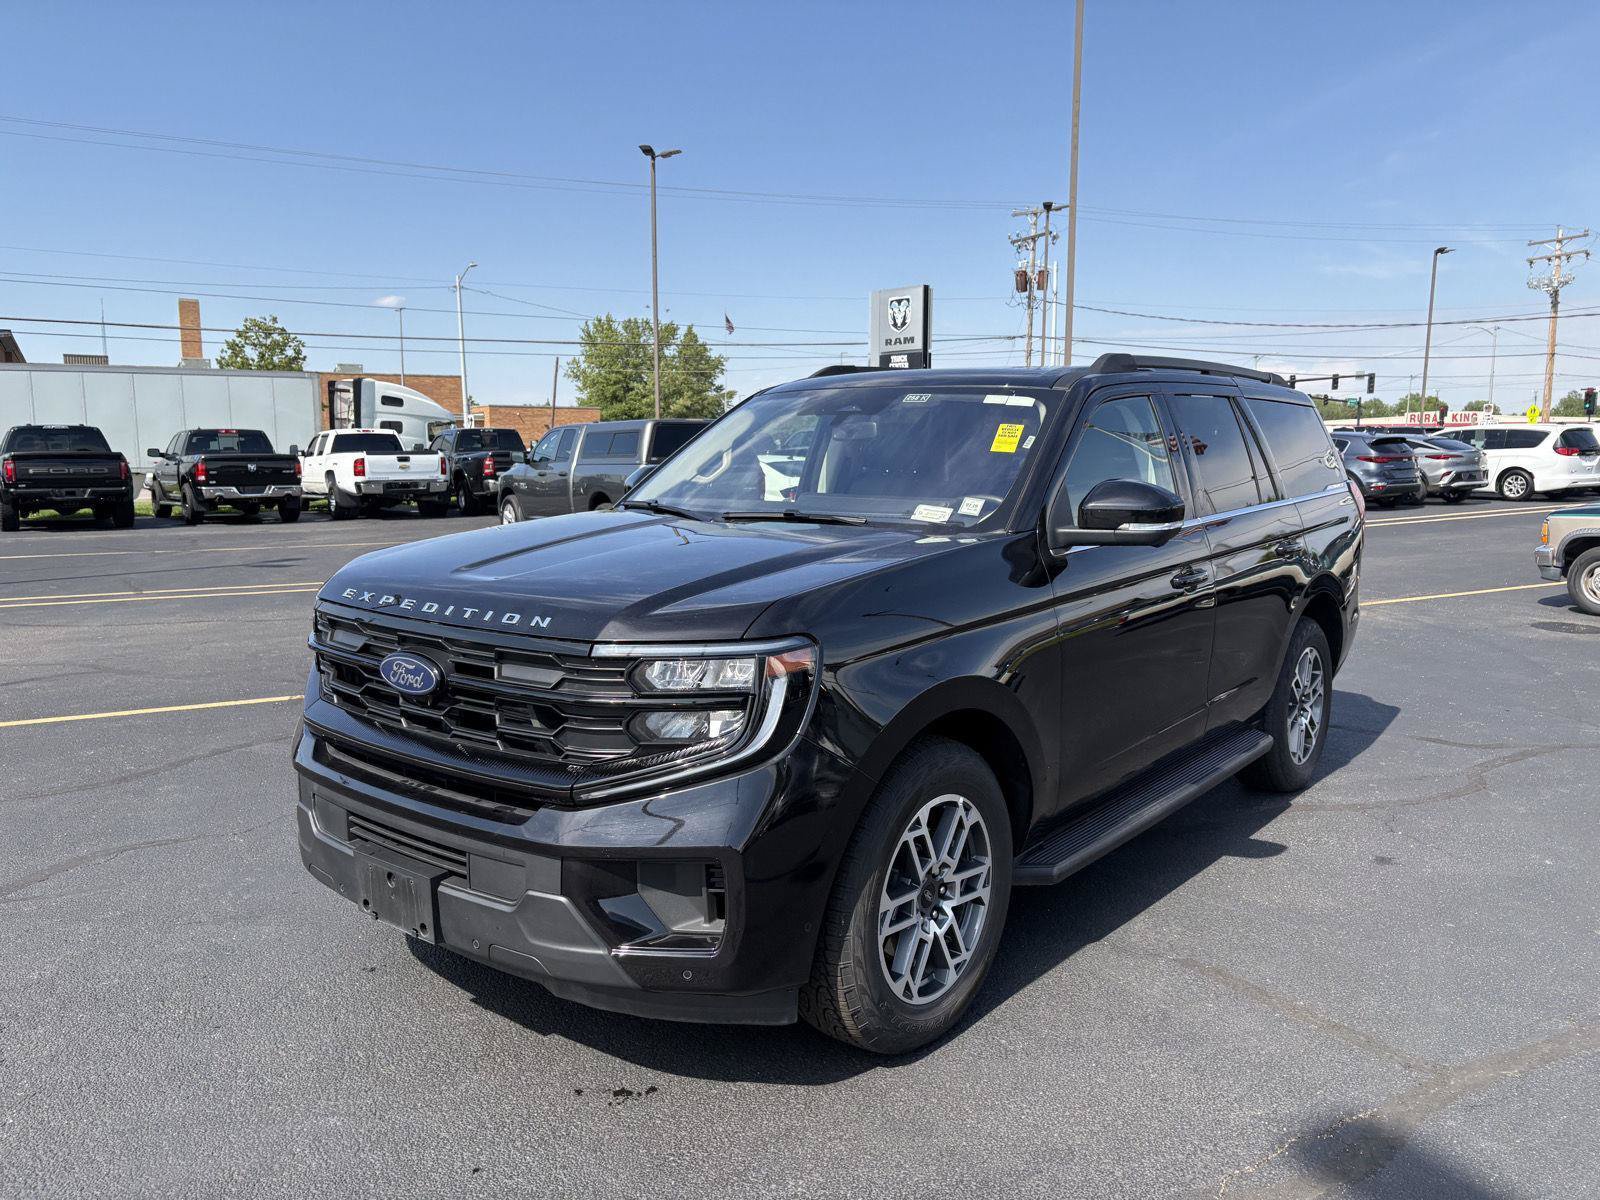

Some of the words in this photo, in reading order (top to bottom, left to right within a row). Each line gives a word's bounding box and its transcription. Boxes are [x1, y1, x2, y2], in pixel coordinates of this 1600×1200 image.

[885, 336, 915, 346] RAM
[1409, 413, 1439, 424] RURA
[1451, 412, 1478, 424] KING
[29, 467, 109, 475] FORD
[341, 587, 553, 629] EXPEDITION
[389, 660, 425, 689] Ford
